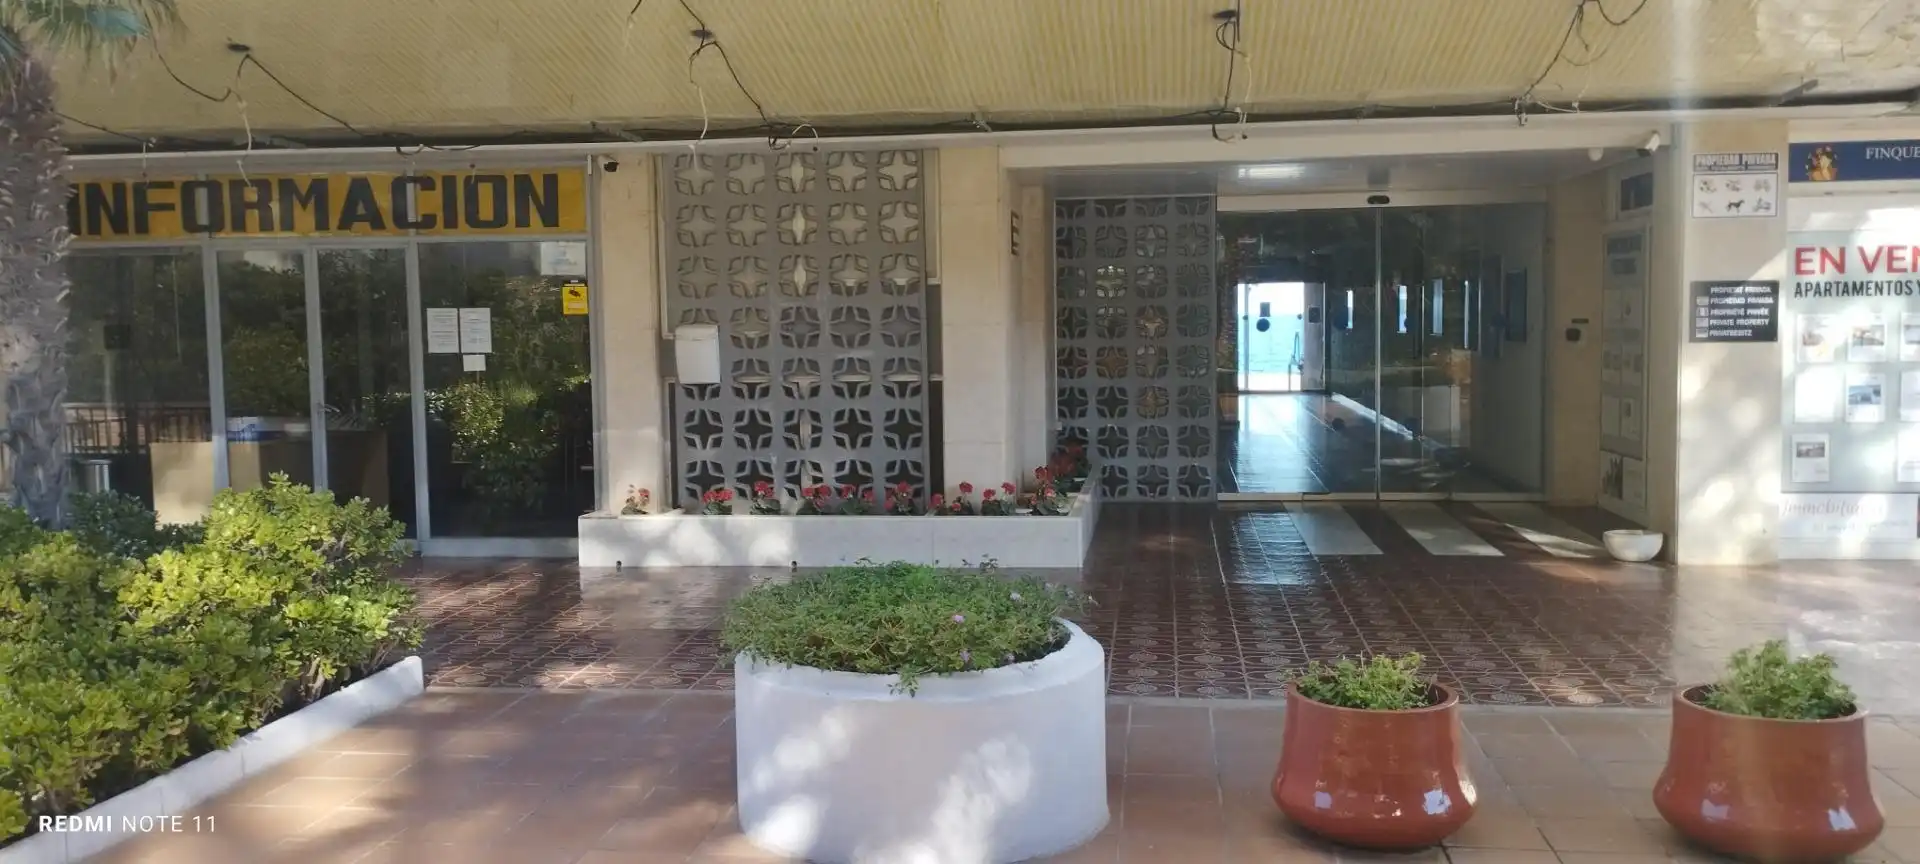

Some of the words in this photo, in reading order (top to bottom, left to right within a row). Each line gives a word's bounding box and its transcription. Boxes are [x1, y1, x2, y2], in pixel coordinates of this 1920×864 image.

[1695, 154, 1739, 167] PROPIEDAD
[1742, 153, 1776, 165] PRIVADA
[66, 172, 560, 235] INFORMACION
[1794, 246, 1846, 275] EN
[1794, 279, 1914, 298] APARTAMENTOS
[1709, 318, 1734, 326] PRIVATE
[1736, 318, 1769, 326] PROPERTY
